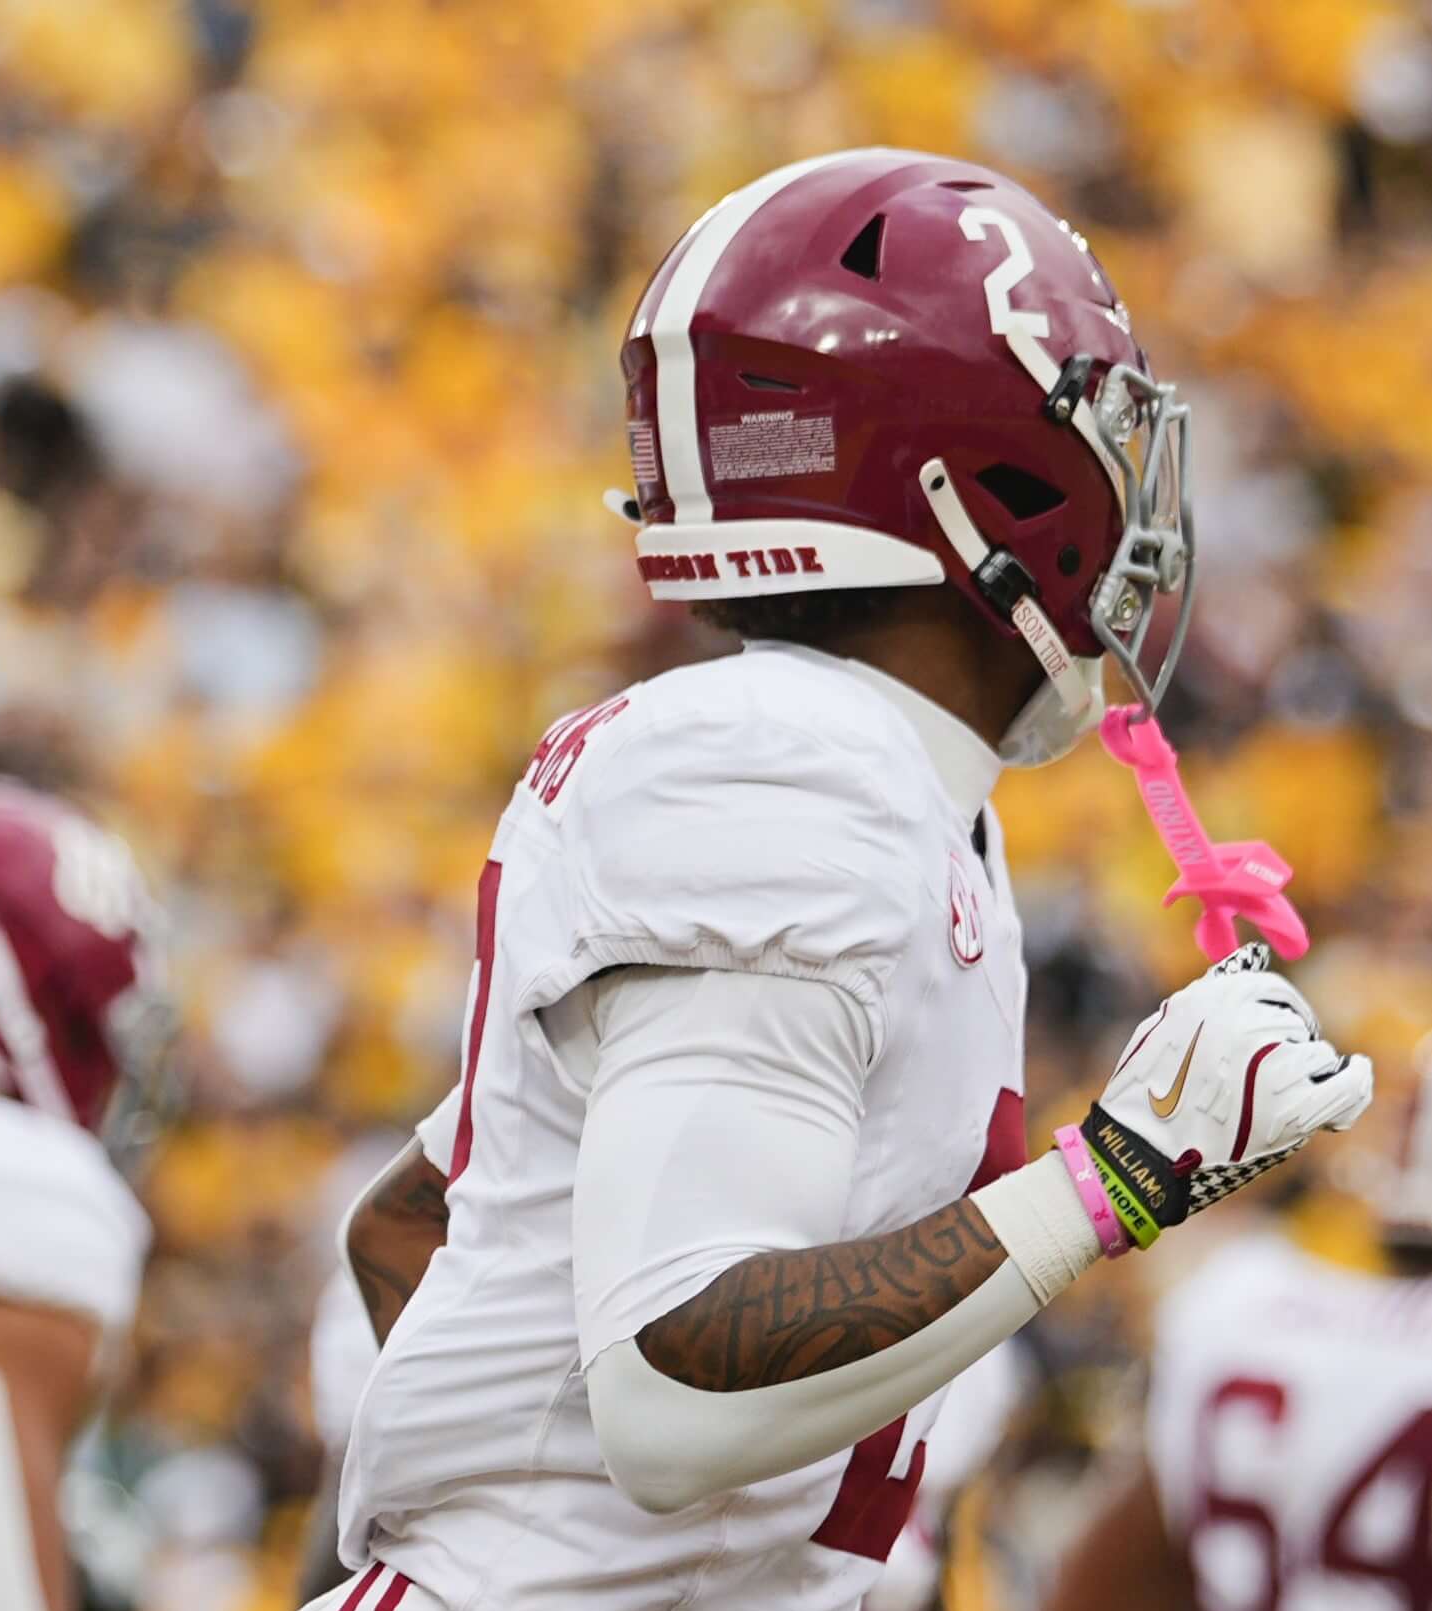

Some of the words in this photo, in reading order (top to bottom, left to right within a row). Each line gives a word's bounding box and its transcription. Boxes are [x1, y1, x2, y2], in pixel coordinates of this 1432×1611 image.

[958, 207, 1050, 339] 2
[739, 411, 795, 425] WARNING
[726, 546, 824, 578] TIDE
[1042, 638, 1069, 678] TIDE
[1097, 1122, 1166, 1209] WILLIAMS
[1107, 1184, 1147, 1231] HOPE
